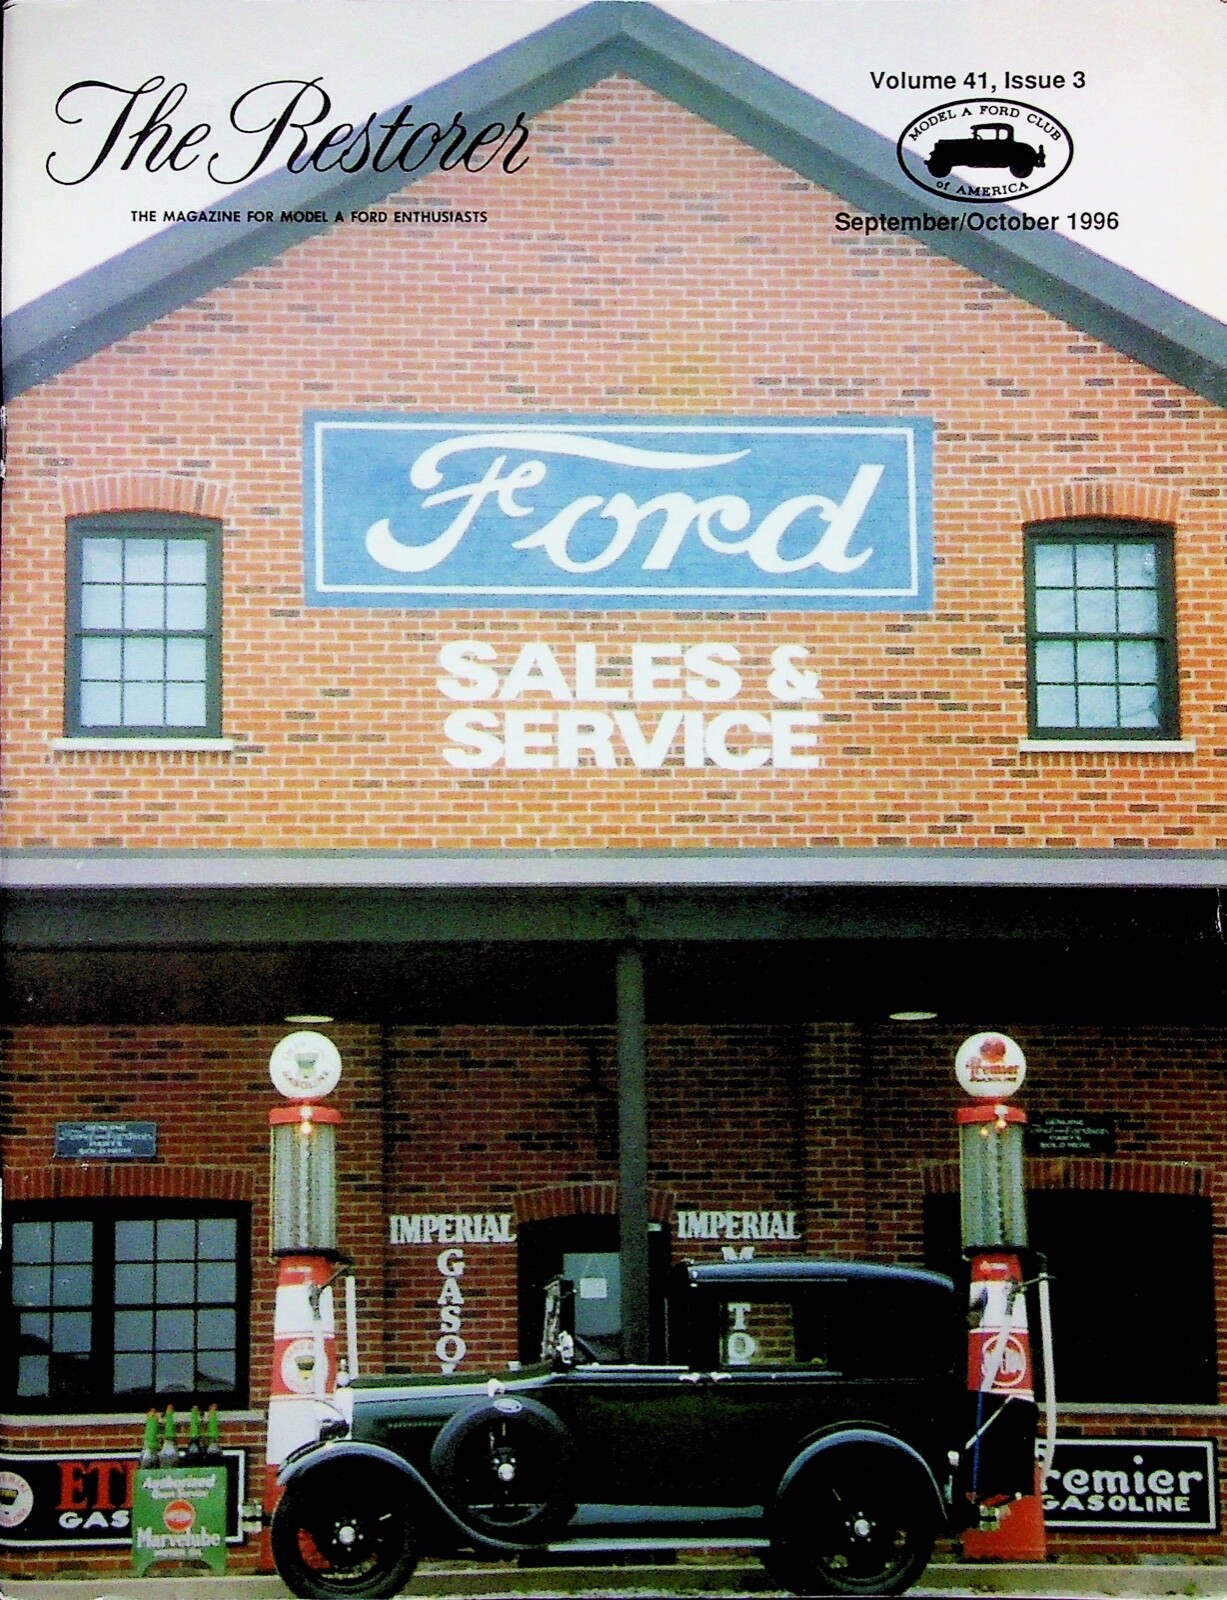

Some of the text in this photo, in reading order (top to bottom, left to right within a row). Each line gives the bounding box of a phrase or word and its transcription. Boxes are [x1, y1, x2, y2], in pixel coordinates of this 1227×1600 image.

[365, 432, 886, 574] Ford
[436, 640, 824, 703] SALES &
[442, 709, 822, 770] SERVICE
[389, 1213, 518, 1244] IMPERIAL
[677, 1210, 802, 1240] IMPERIAL
[1035, 1454, 1204, 1495] remier
[1041, 1493, 1191, 1513] GASOLINE
